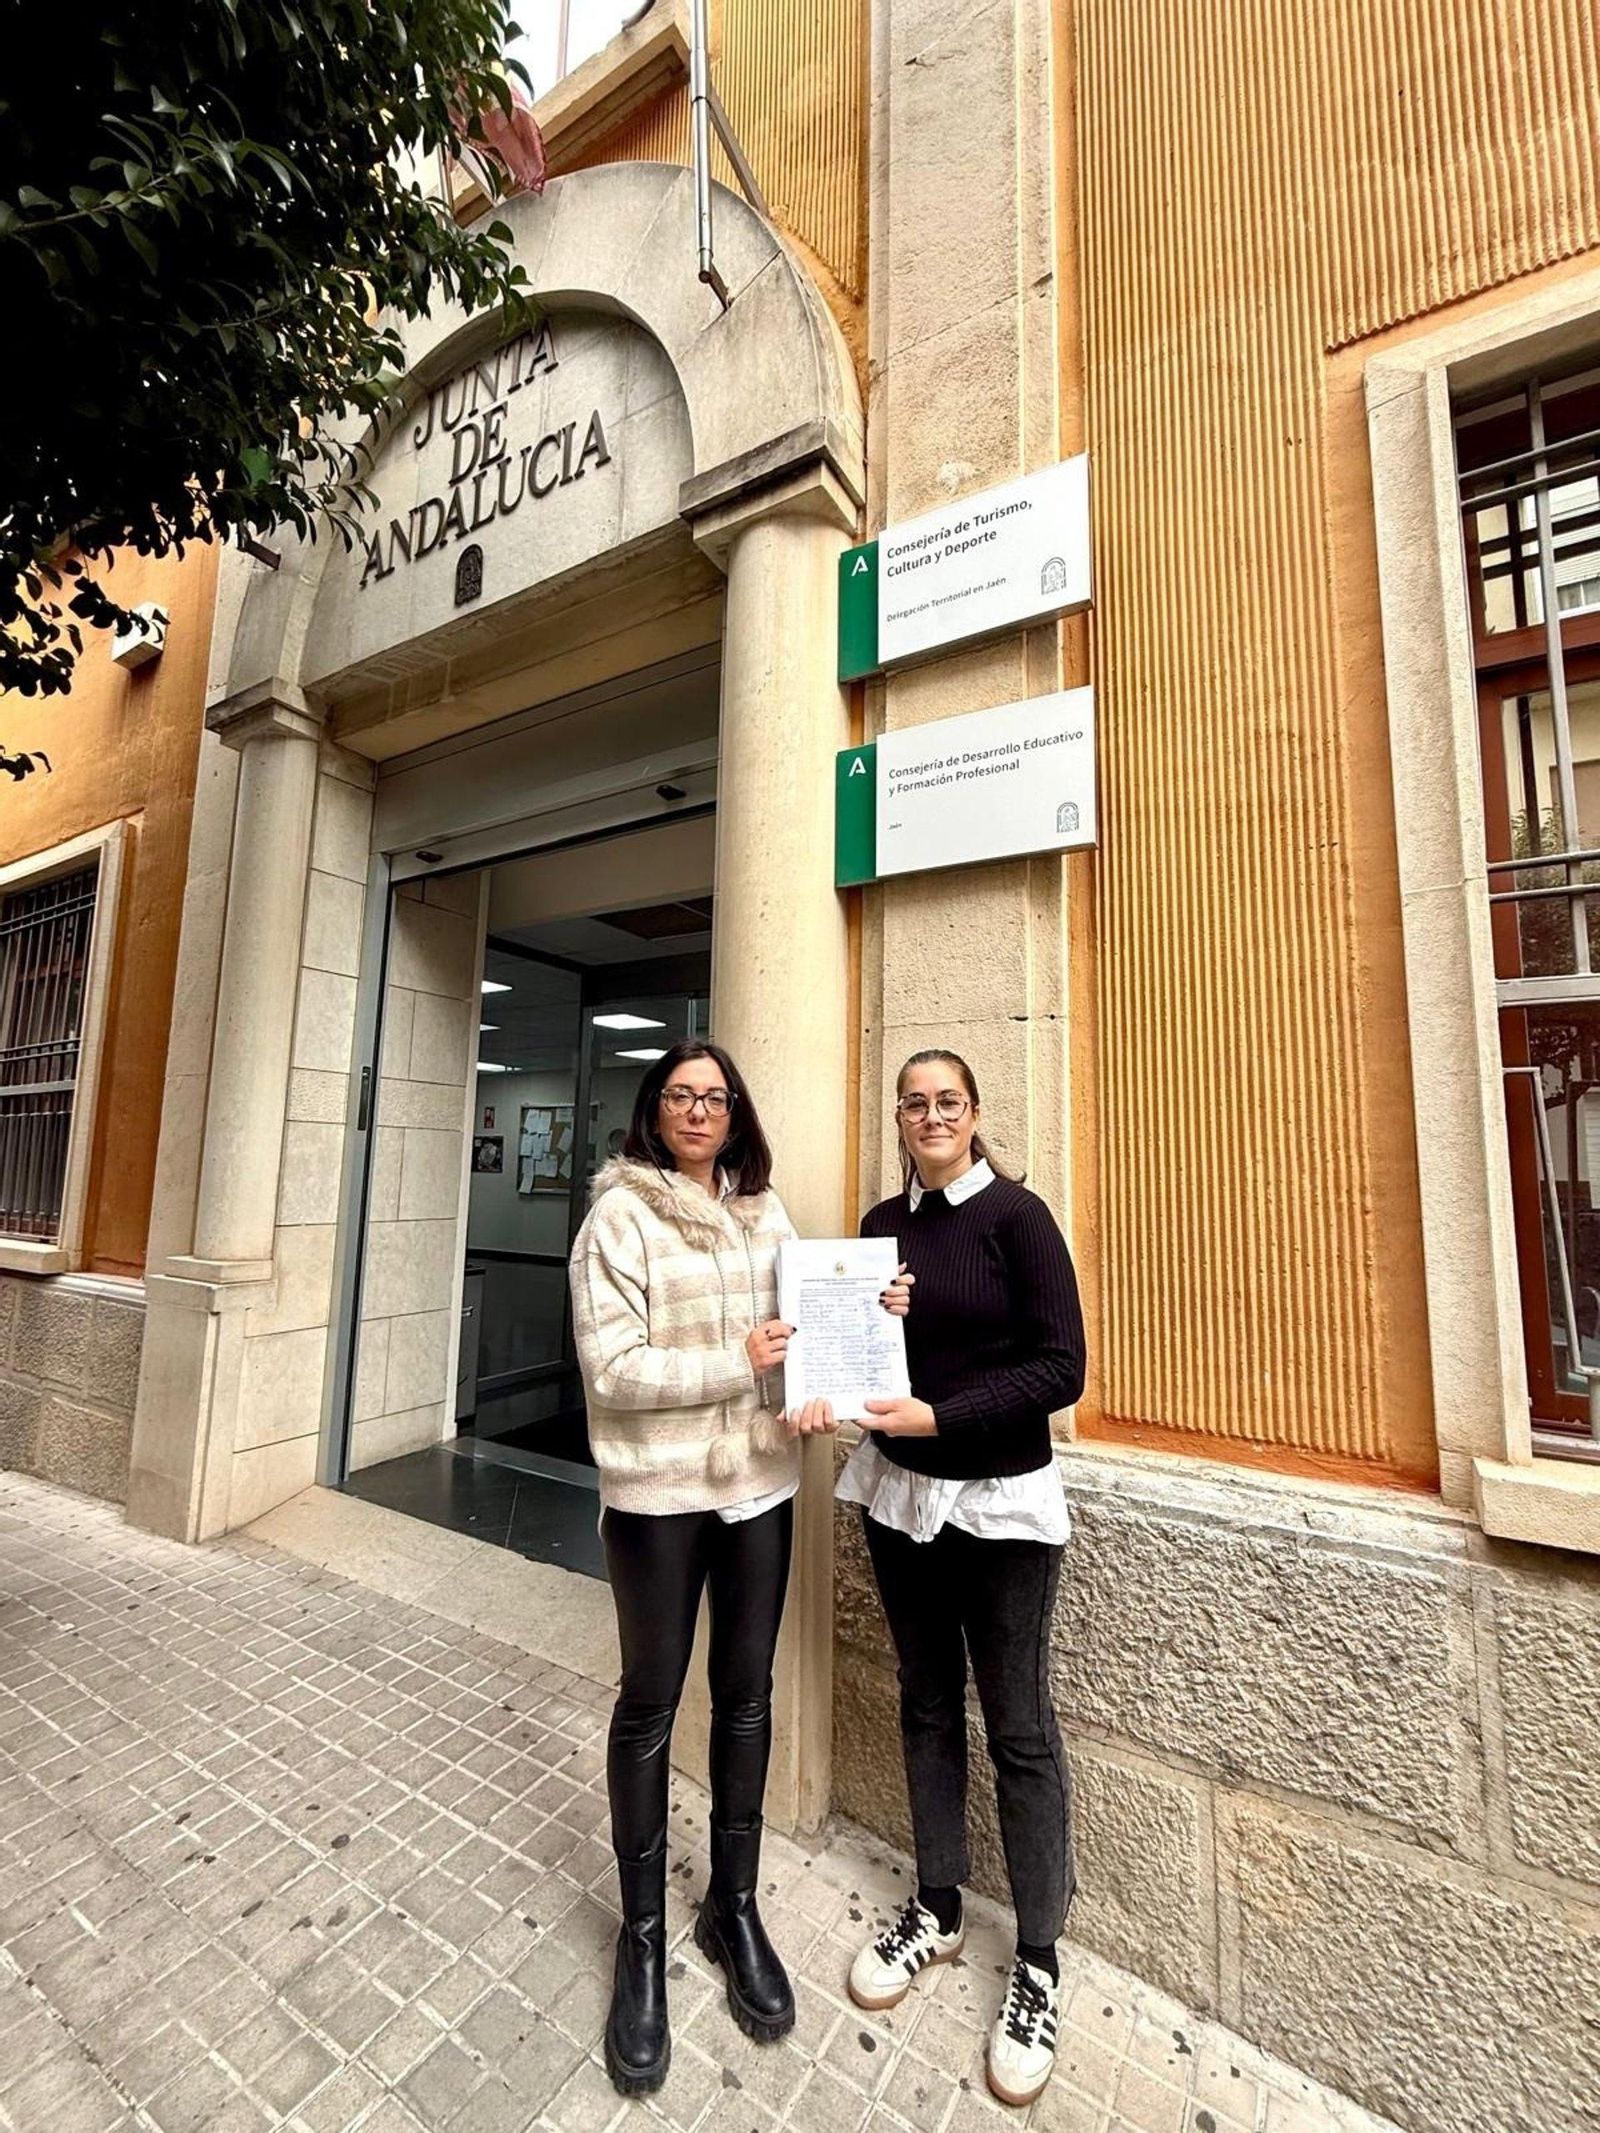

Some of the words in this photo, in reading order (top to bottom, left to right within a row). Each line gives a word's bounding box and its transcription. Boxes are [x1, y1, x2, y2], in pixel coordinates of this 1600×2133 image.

[413, 319, 559, 451] JUNTA
[449, 401, 508, 488] DE
[359, 409, 612, 590] ANDALUCIA
[887, 526, 951, 559] Consejería
[954, 519, 970, 535] de
[973, 500, 1033, 527] Turismo,
[887, 553, 932, 578] Cultura
[934, 551, 942, 565] y
[944, 529, 997, 557] Deporte
[931, 587, 971, 607] Territorial
[973, 584, 984, 594] en
[985, 577, 1006, 590] Jaén
[888, 758, 944, 779] Consejería
[946, 755, 960, 768] de
[962, 742, 1021, 765] Desarrollo
[1023, 729, 1084, 752] Educativo
[888, 785, 895, 797] y
[897, 772, 953, 794] Formación
[956, 759, 1020, 783] Profesional
